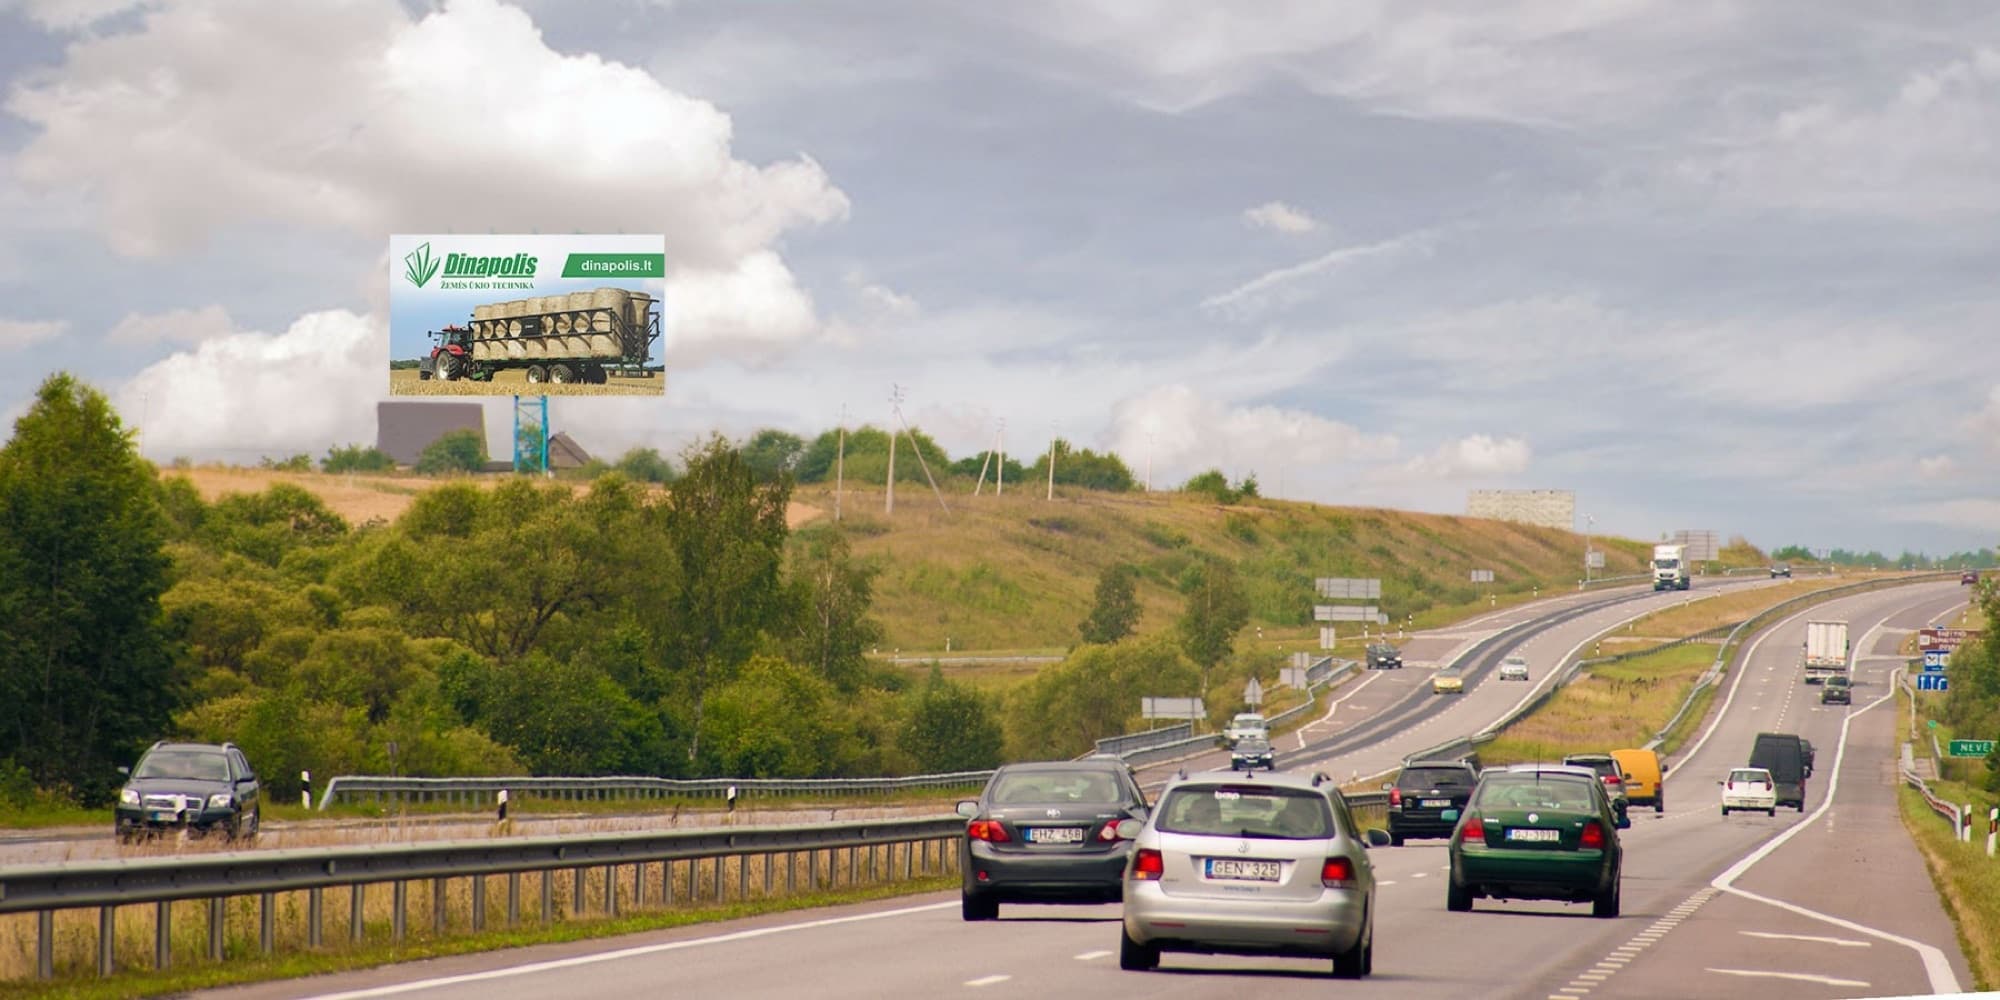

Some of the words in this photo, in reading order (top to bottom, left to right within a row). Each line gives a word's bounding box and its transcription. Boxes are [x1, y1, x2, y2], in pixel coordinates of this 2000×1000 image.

[443, 253, 538, 277] Dinapolis
[581, 260, 652, 272] dinapolis.lt
[492, 281, 534, 289] TECHNIKA
[1214, 861, 1244, 874] GEN
[1252, 863, 1278, 876] 325
